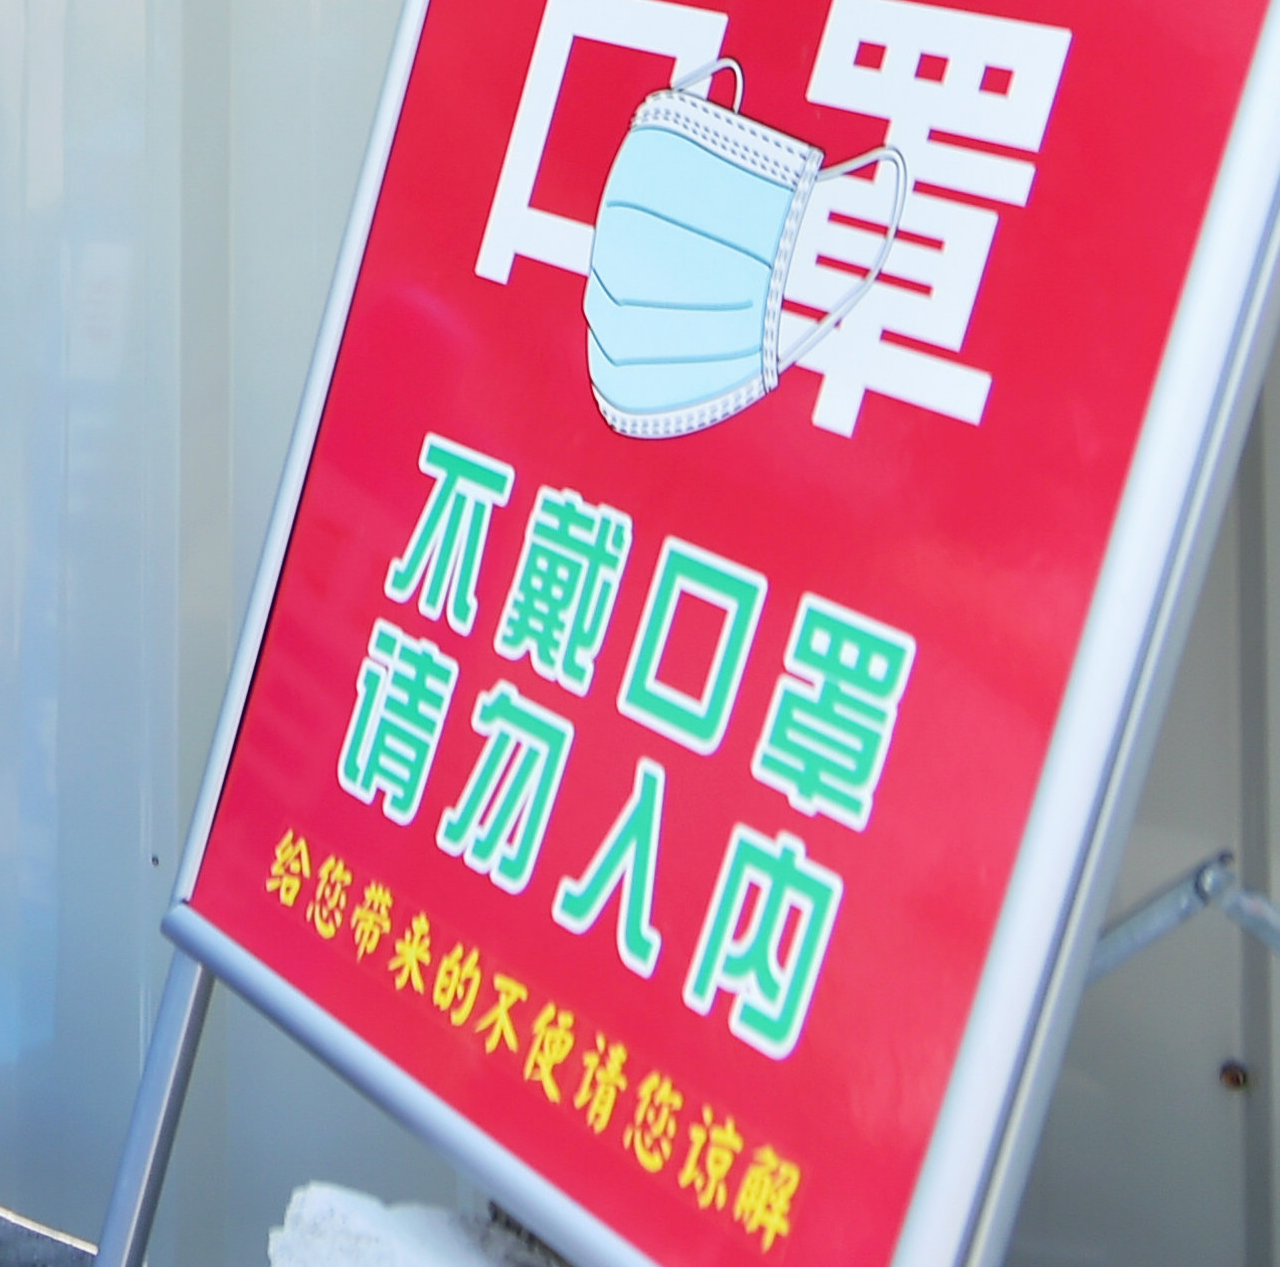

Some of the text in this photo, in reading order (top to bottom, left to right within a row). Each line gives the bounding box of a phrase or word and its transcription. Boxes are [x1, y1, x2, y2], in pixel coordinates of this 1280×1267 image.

[384, 431, 917, 833] 不戴口罩
[264, 827, 802, 1254] 给您带来的不便请您谅解
